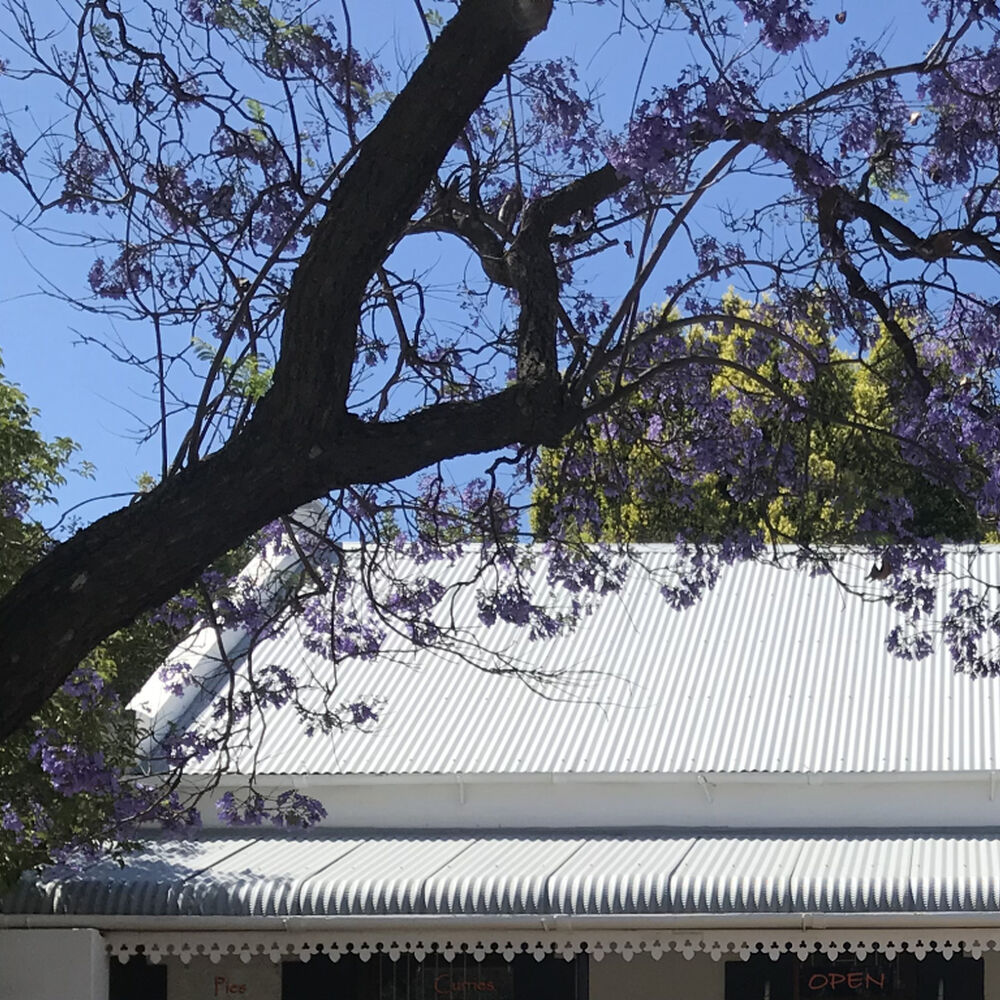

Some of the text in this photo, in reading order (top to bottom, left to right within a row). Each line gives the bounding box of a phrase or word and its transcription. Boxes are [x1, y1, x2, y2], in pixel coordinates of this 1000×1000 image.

[214, 976, 248, 997] Pies
[434, 973, 495, 995] Curries
[808, 972, 885, 990] OPEN
